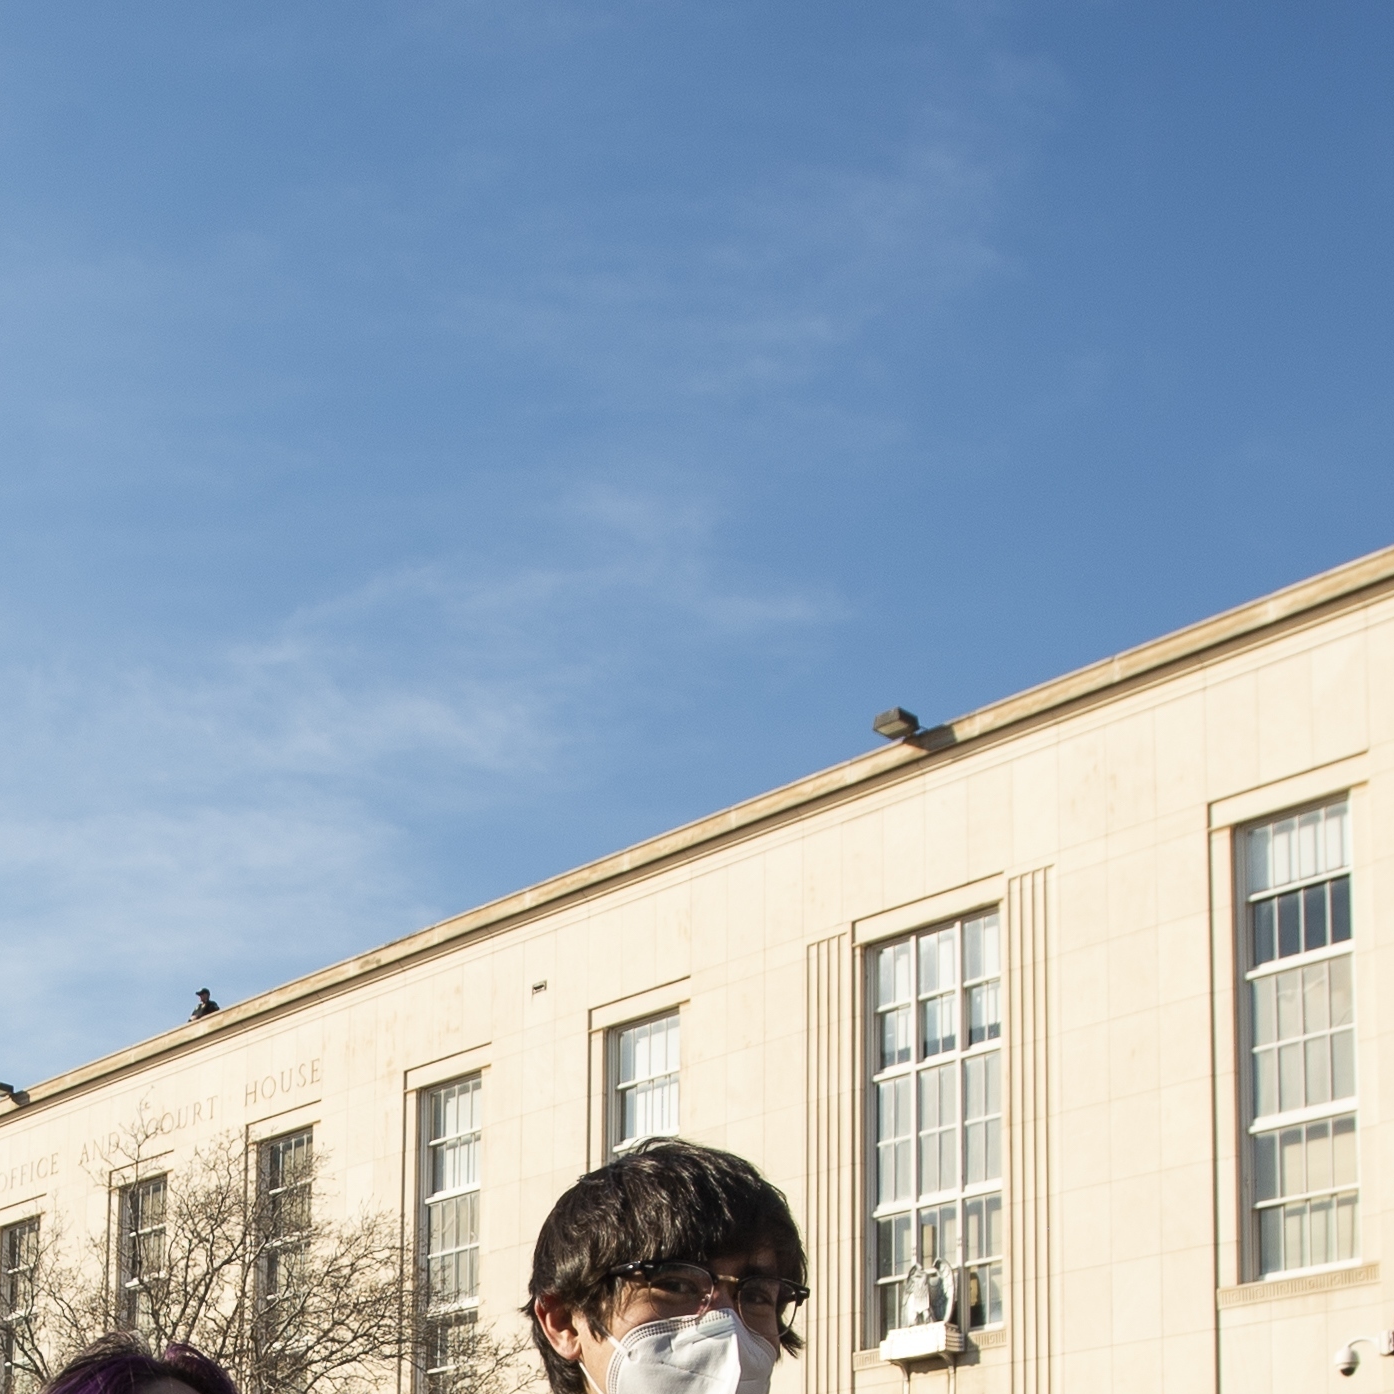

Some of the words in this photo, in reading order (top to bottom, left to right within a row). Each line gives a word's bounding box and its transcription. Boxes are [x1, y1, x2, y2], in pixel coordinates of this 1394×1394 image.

[78, 1131, 121, 1166] AND
[145, 1096, 219, 1136] COURT
[244, 1057, 322, 1107] HOUSE
